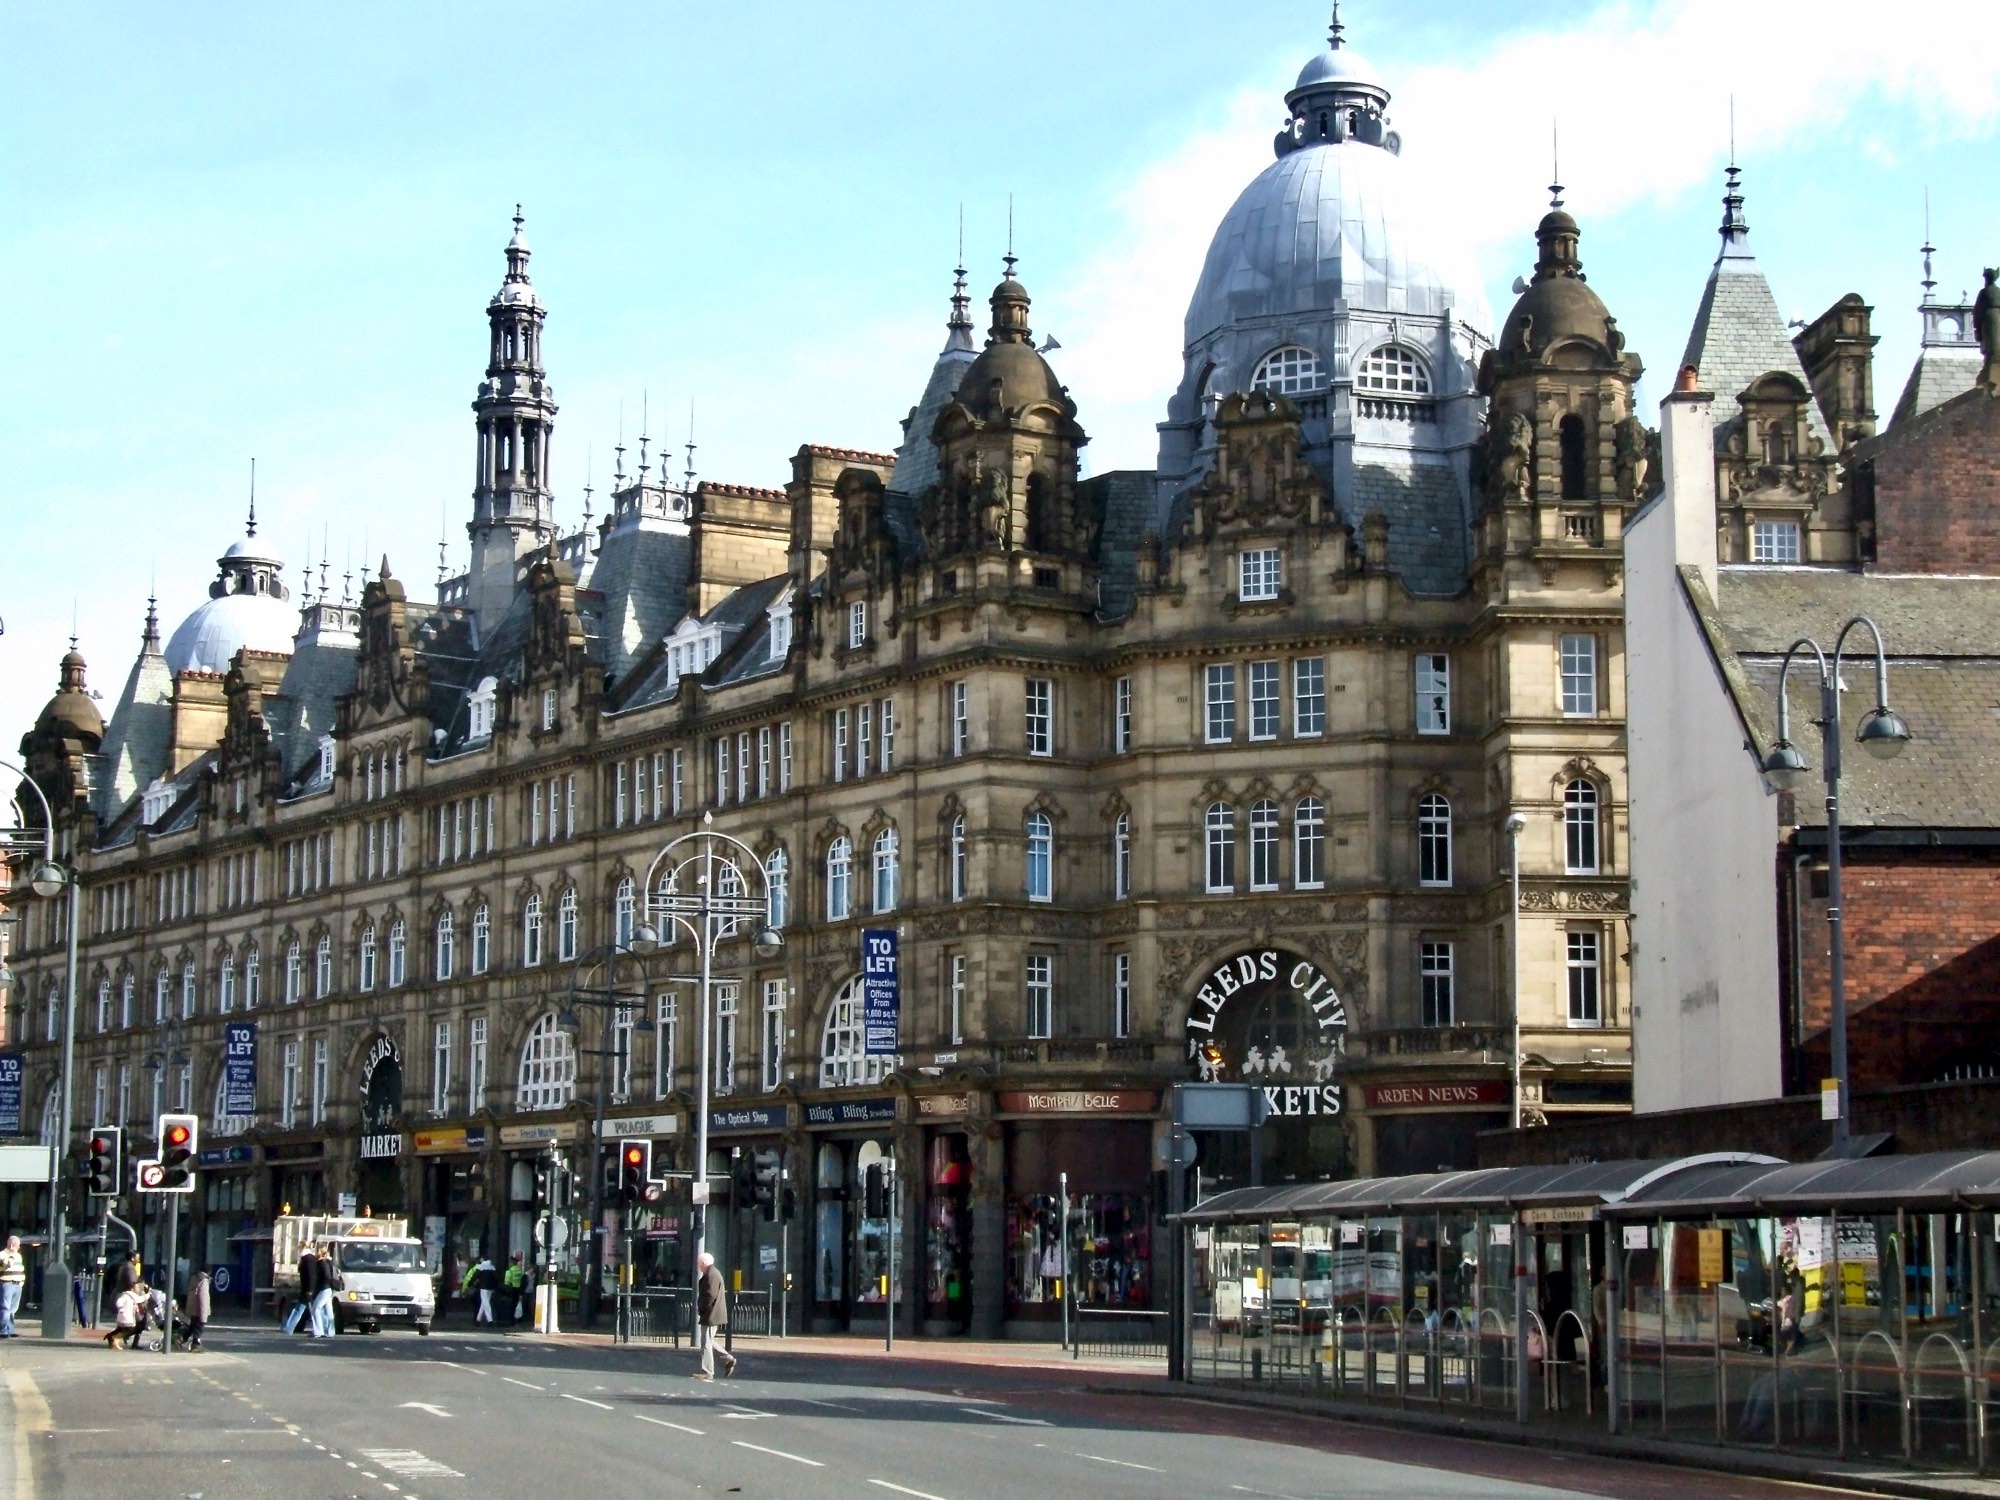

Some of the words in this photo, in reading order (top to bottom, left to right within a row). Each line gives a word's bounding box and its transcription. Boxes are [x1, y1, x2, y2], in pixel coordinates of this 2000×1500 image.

[869, 938, 892, 955] TO
[866, 956, 896, 973] LET
[865, 978, 897, 988] Attractive
[870, 989, 893, 999] Offices
[1187, 951, 1277, 1033] LEEDS
[1290, 961, 1347, 1030] CITY
[873, 998, 890, 1007] From
[231, 1029, 250, 1042] TO
[228, 1043, 253, 1055] LET
[1, 1059, 18, 1070] TO
[359, 1036, 391, 1095] LEEDS
[1028, 1094, 1080, 1109] MEMPHIS
[1085, 1094, 1119, 1108] BELLE
[1264, 1086, 1340, 1115] KETS
[1377, 1088, 1423, 1104] ARDEN
[1428, 1086, 1478, 1101] NEWS
[713, 1113, 726, 1125] The
[728, 1112, 750, 1126] Optical
[752, 1111, 769, 1124] Shop
[808, 1107, 835, 1122] Bling
[843, 1105, 869, 1119] Bling
[614, 1120, 655, 1134] PRAGUE
